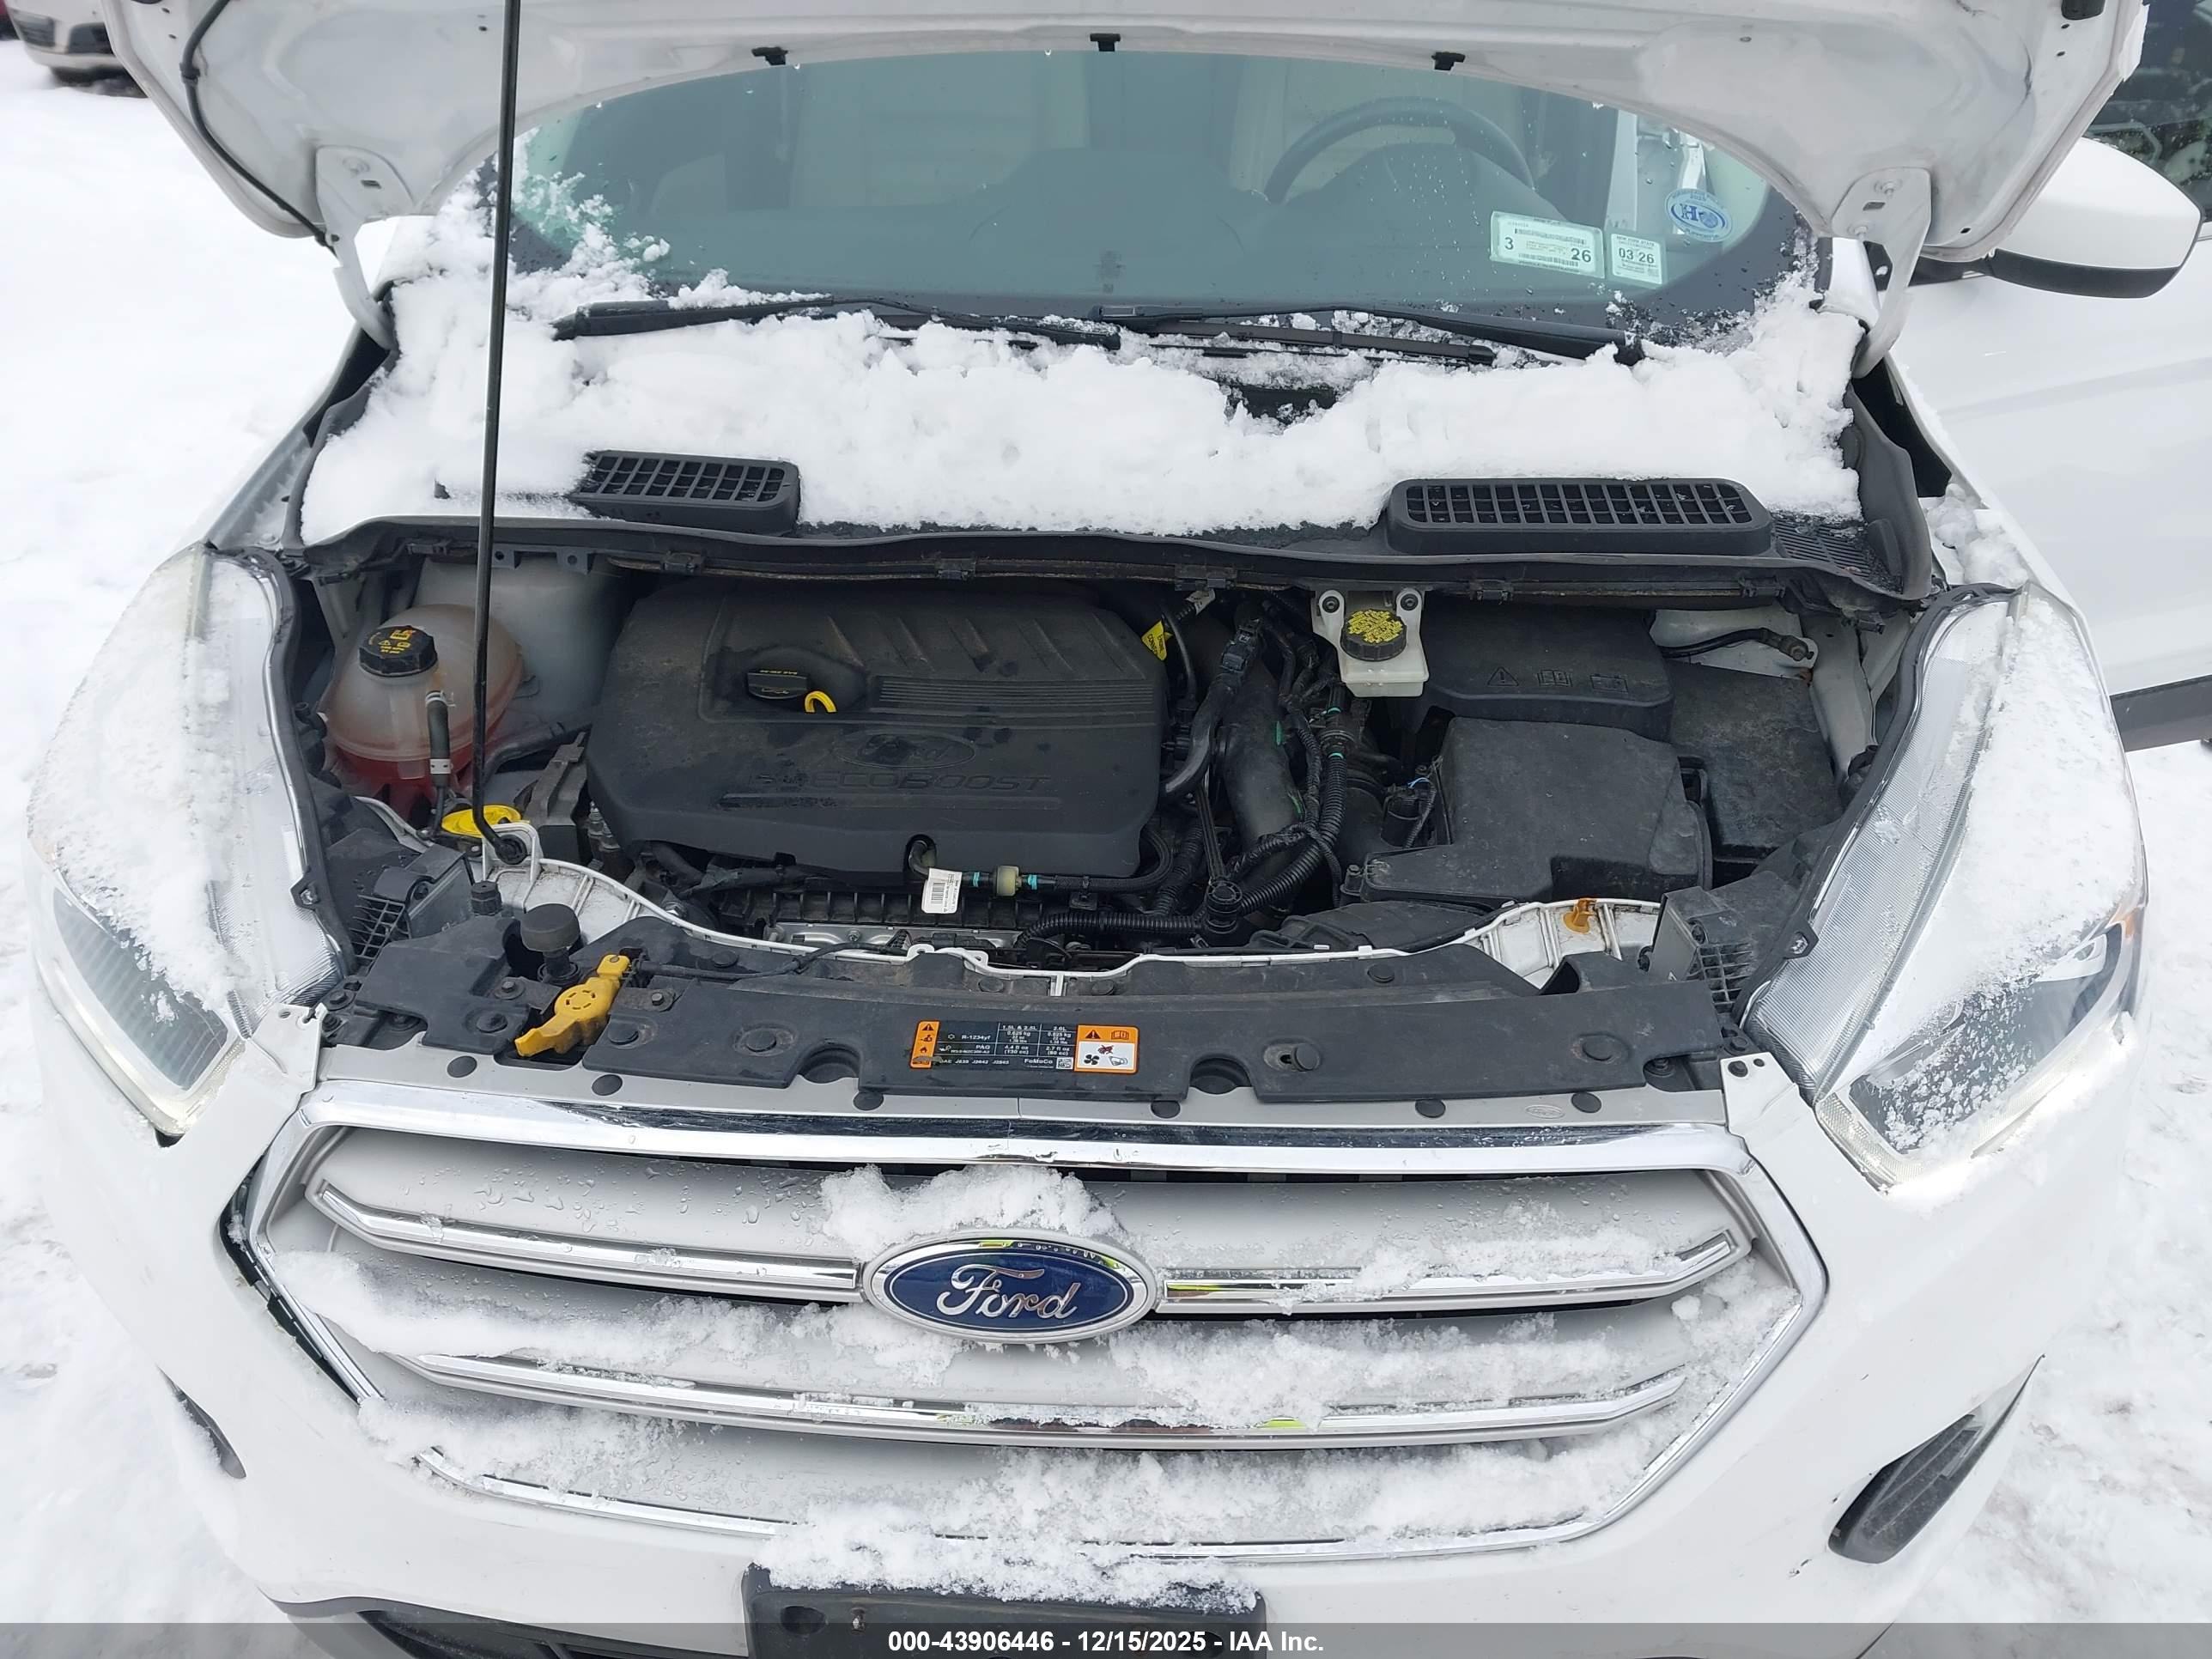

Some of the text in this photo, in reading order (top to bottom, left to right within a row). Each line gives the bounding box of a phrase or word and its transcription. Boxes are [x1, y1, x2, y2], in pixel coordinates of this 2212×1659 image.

[1504, 236, 1514, 250] 3
[1570, 247, 1592, 263] 26
[1619, 247, 1654, 264] 03 26
[936, 1263, 1082, 1320] Ford
